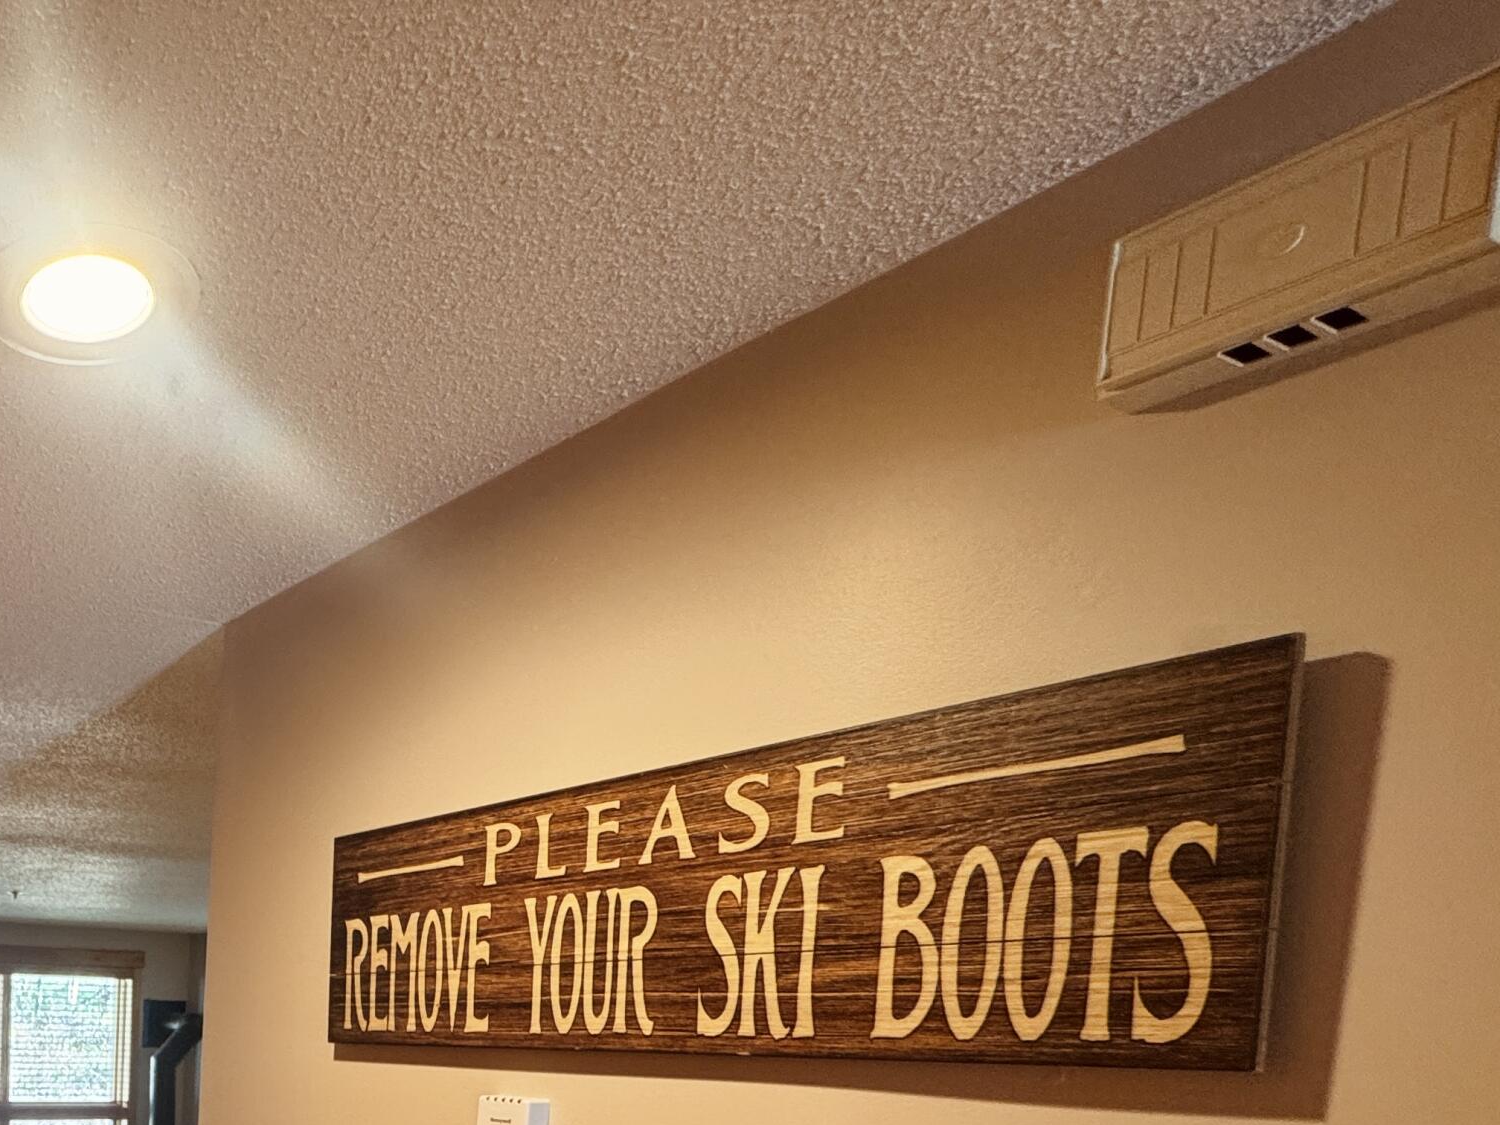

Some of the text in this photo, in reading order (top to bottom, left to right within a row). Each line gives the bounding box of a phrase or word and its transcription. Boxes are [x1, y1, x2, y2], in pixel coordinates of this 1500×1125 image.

[483, 756, 848, 886] PLEASE
[344, 821, 1218, 1043] REMOVE YOUR SKI BOOTS
